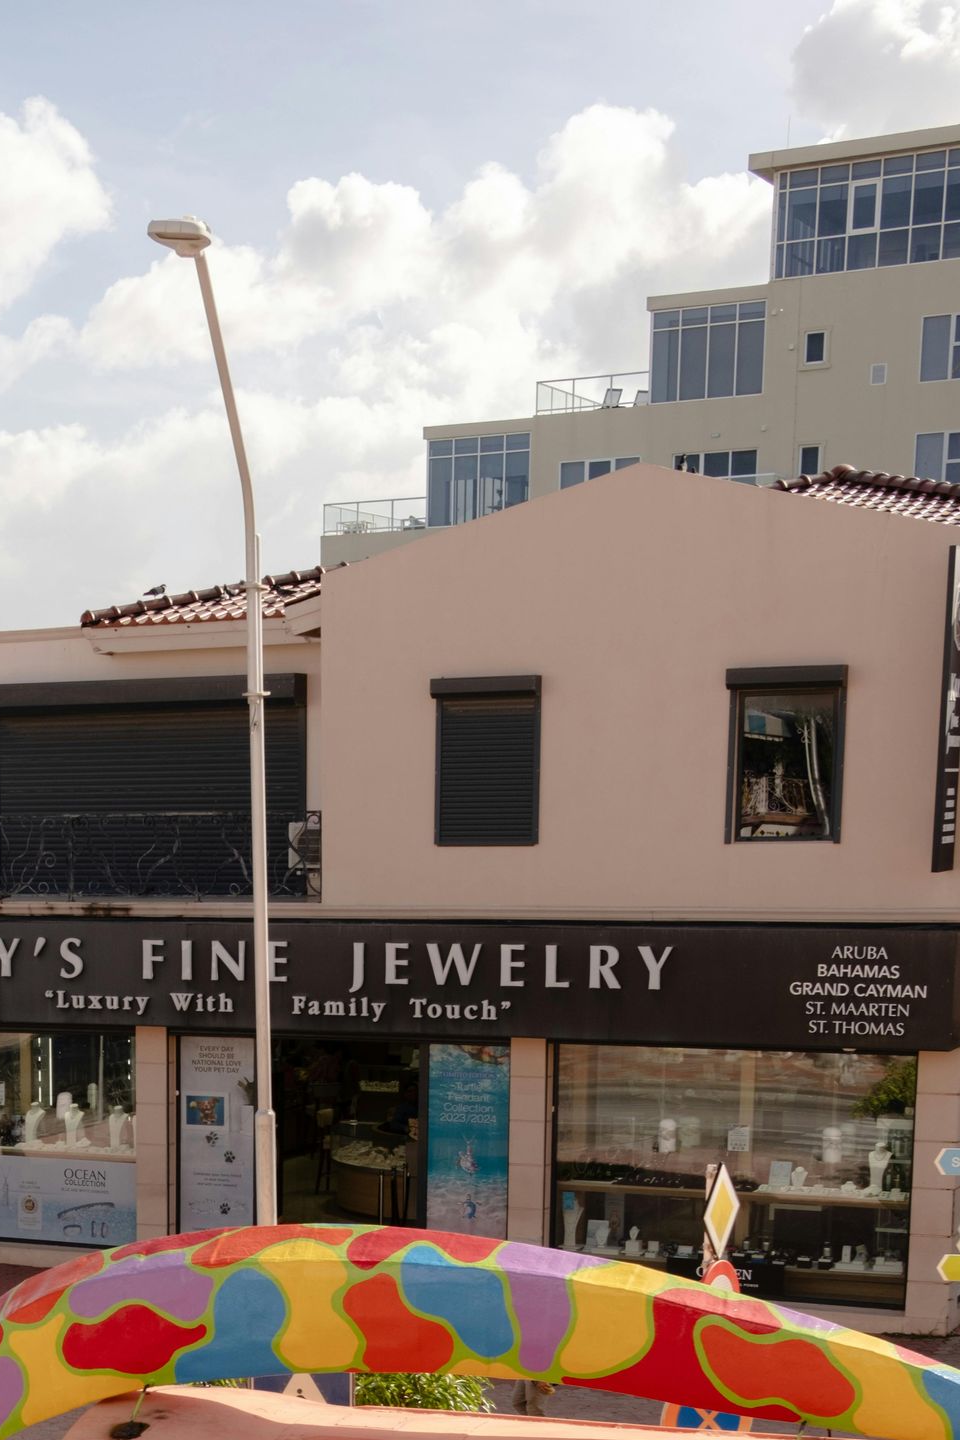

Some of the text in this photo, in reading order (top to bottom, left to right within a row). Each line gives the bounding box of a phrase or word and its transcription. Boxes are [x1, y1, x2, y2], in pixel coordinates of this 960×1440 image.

[831, 945, 888, 960] ARUBA
[142, 939, 288, 982] FINE
[349, 942, 674, 993] JEWELRY
[817, 963, 900, 979] BAHAMAS
[789, 981, 928, 999] GRAND CAYMAN
[170, 992, 234, 1013] With
[292, 995, 387, 1022] Family
[805, 1001, 910, 1017] ST. MAARTEN
[808, 1020, 905, 1036] ST. THOMAS
[448, 1092, 490, 1102] Pendant
[444, 1102, 494, 1113] Collection
[64, 1168, 106, 1181] OCEAN
[64, 1179, 106, 1188] COLLECTION
